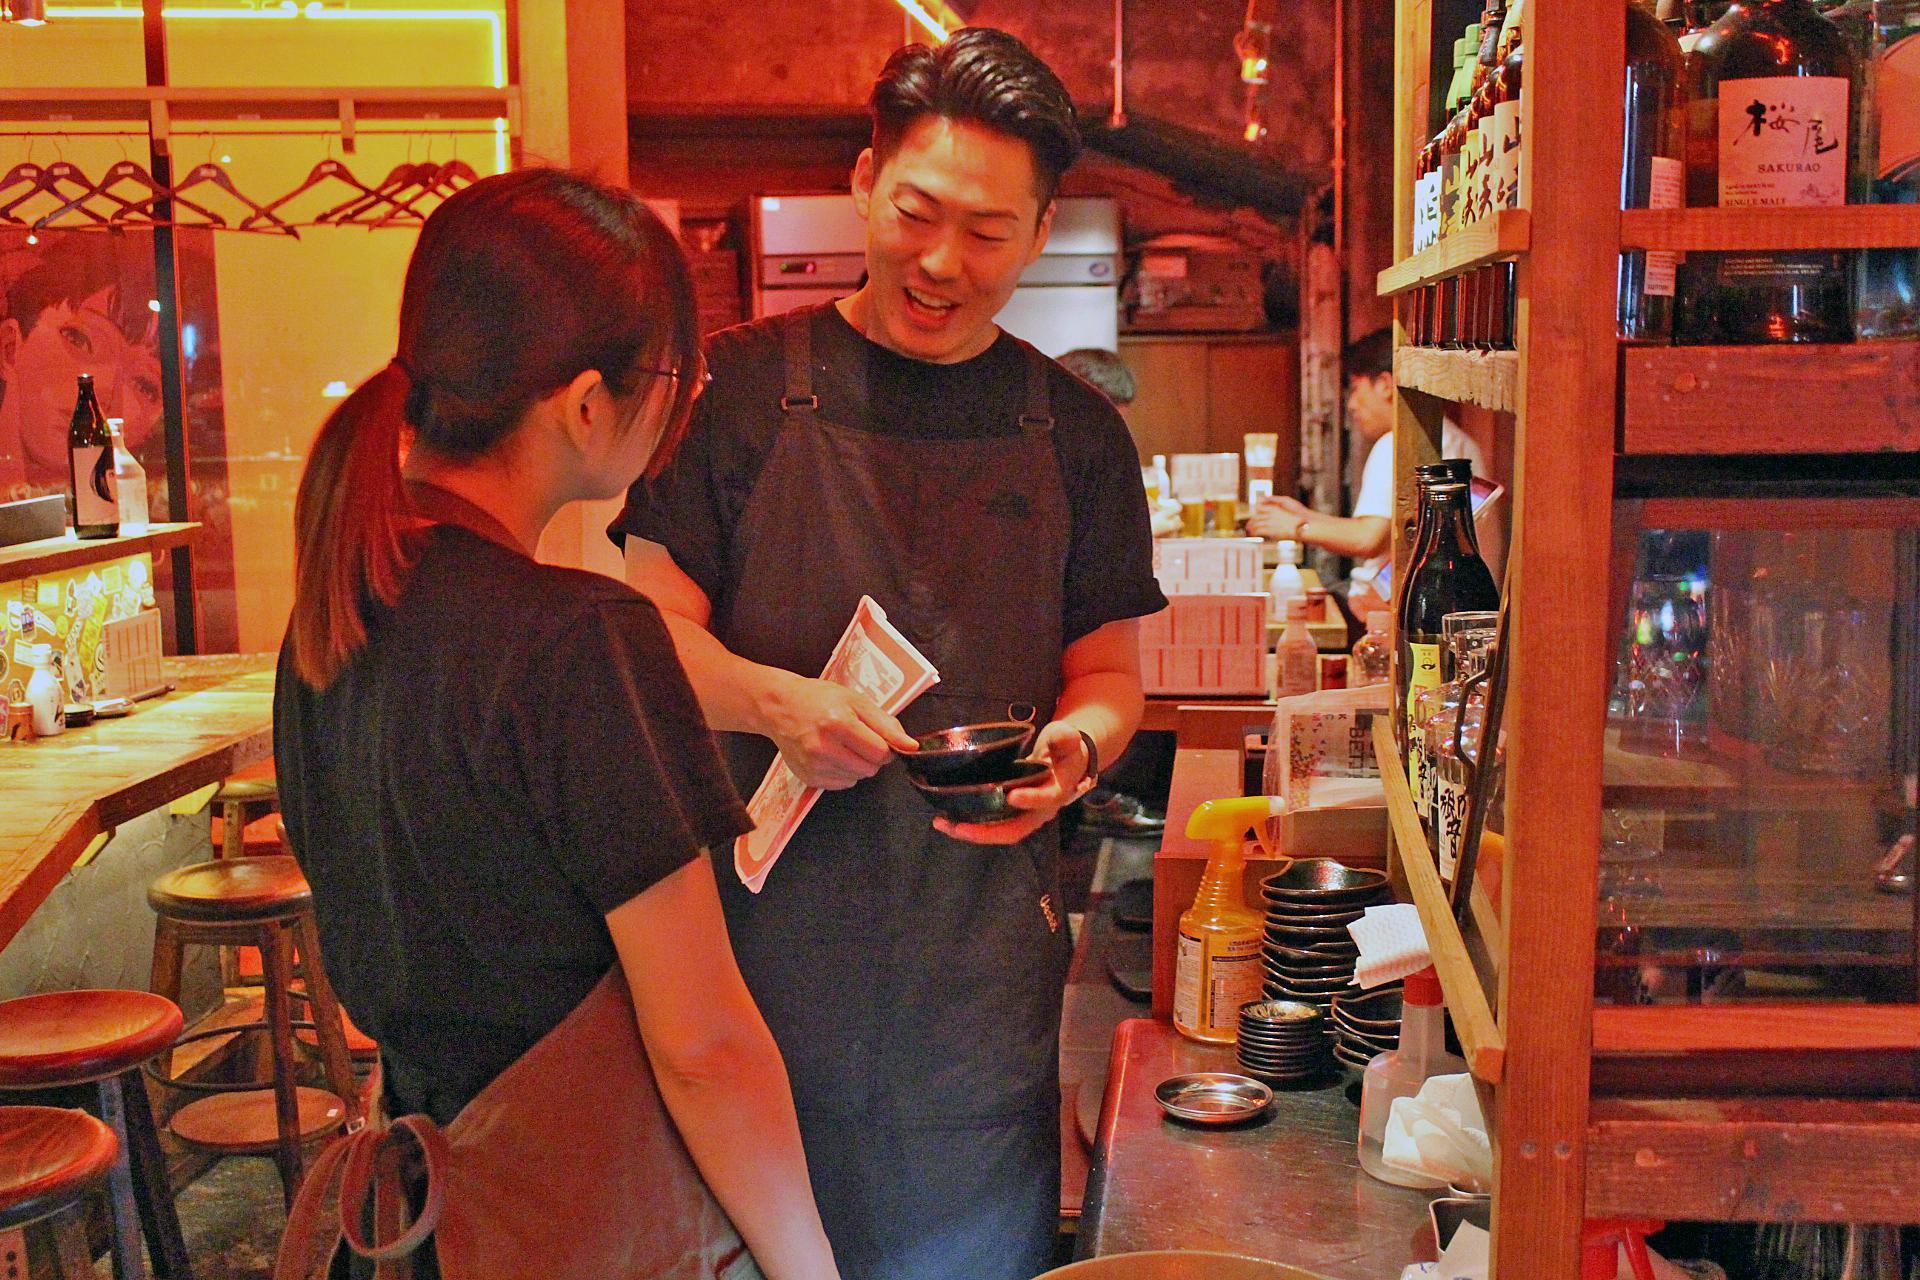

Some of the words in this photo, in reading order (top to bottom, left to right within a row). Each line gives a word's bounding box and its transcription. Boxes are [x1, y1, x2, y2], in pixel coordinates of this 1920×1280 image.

[1732, 98, 1839, 155] 桜尾
[1757, 163, 1821, 174] SAKURAO
[1725, 198, 1758, 206] SINGLE
[1760, 197, 1785, 205] MALT
[1440, 787, 1468, 860] 響
